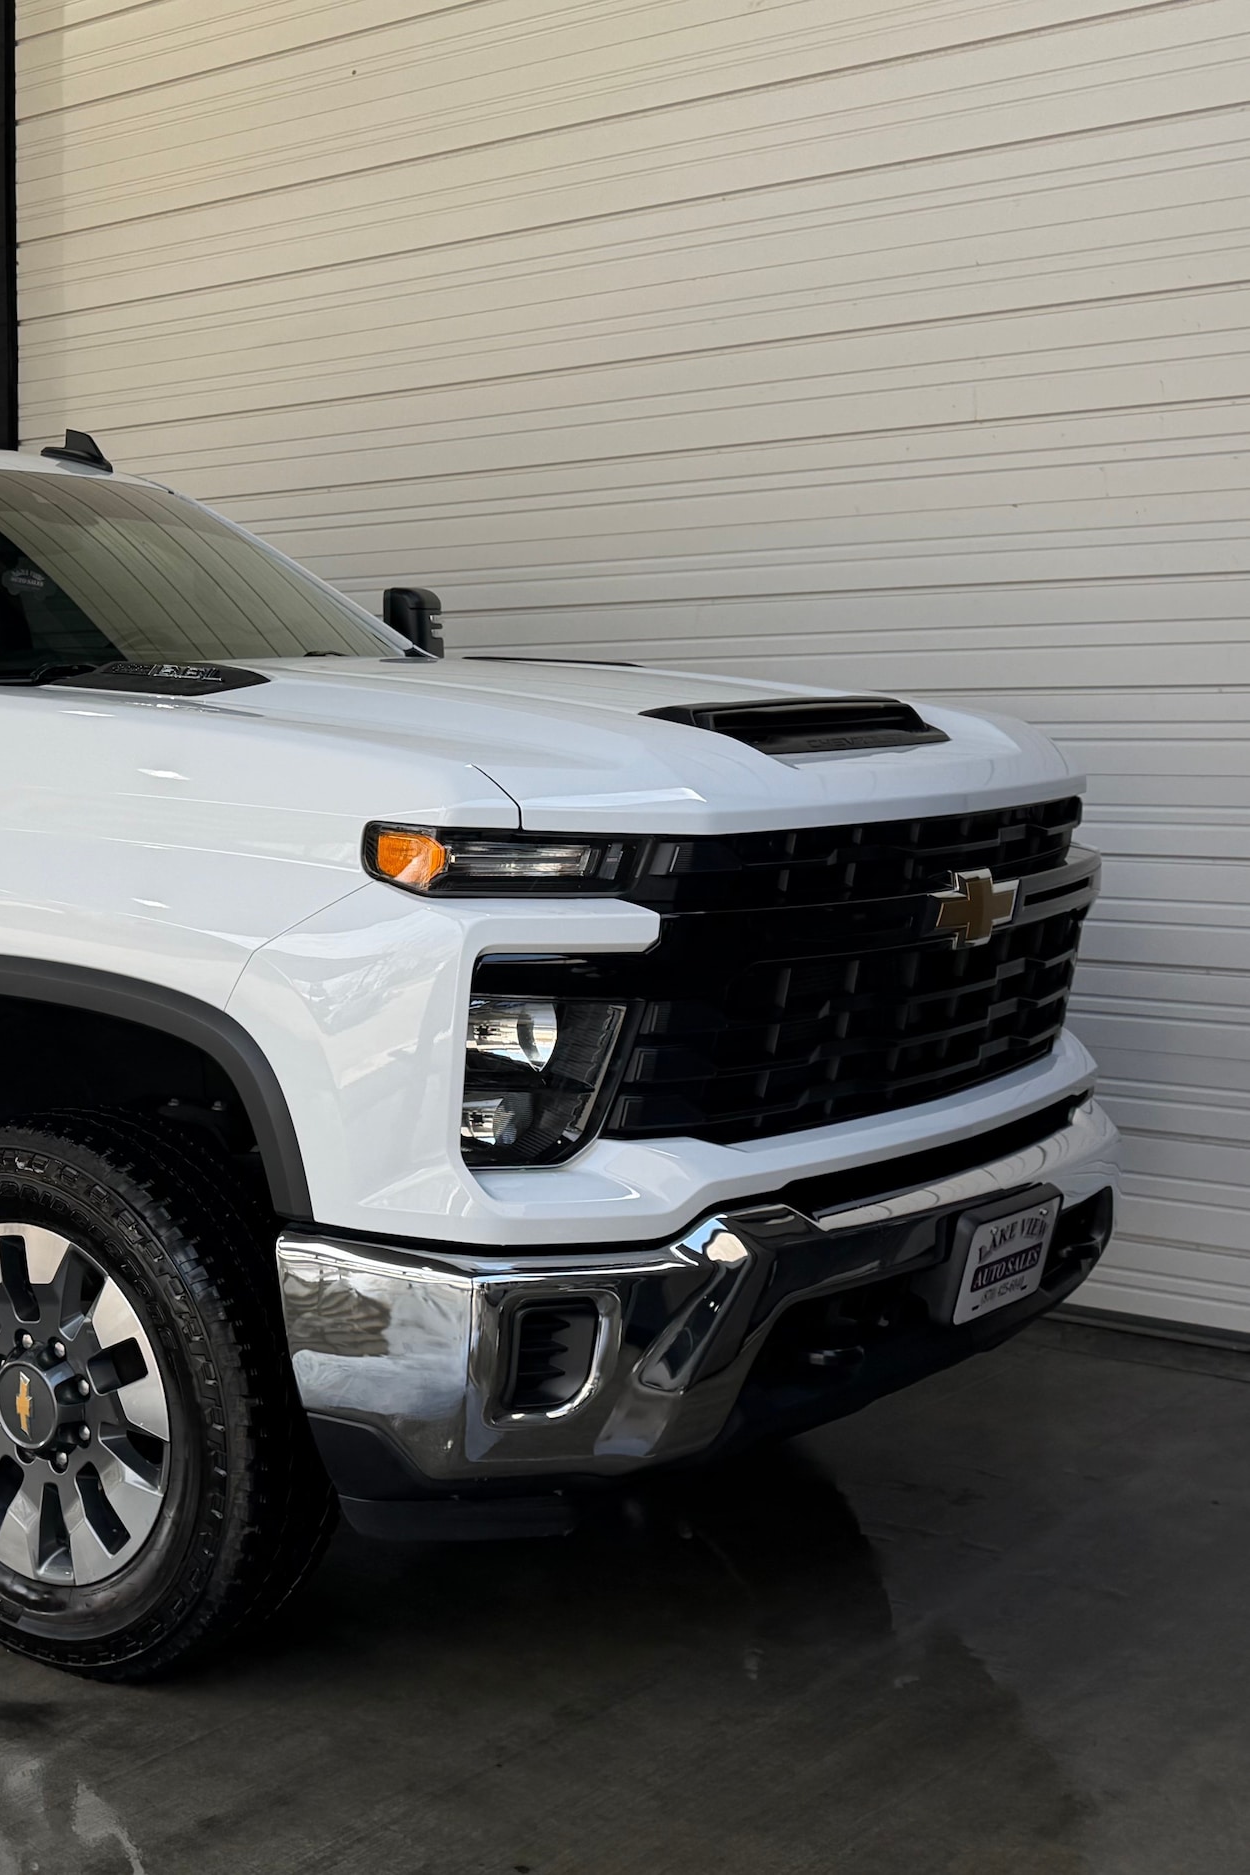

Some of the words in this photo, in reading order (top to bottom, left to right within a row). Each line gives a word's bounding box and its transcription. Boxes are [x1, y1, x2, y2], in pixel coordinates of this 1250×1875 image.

[978, 1221, 1019, 1264] LAKE
[1021, 1217, 1050, 1241] VIEW
[973, 1260, 1006, 1289] AUTO
[1005, 1248, 1039, 1279] SALES
